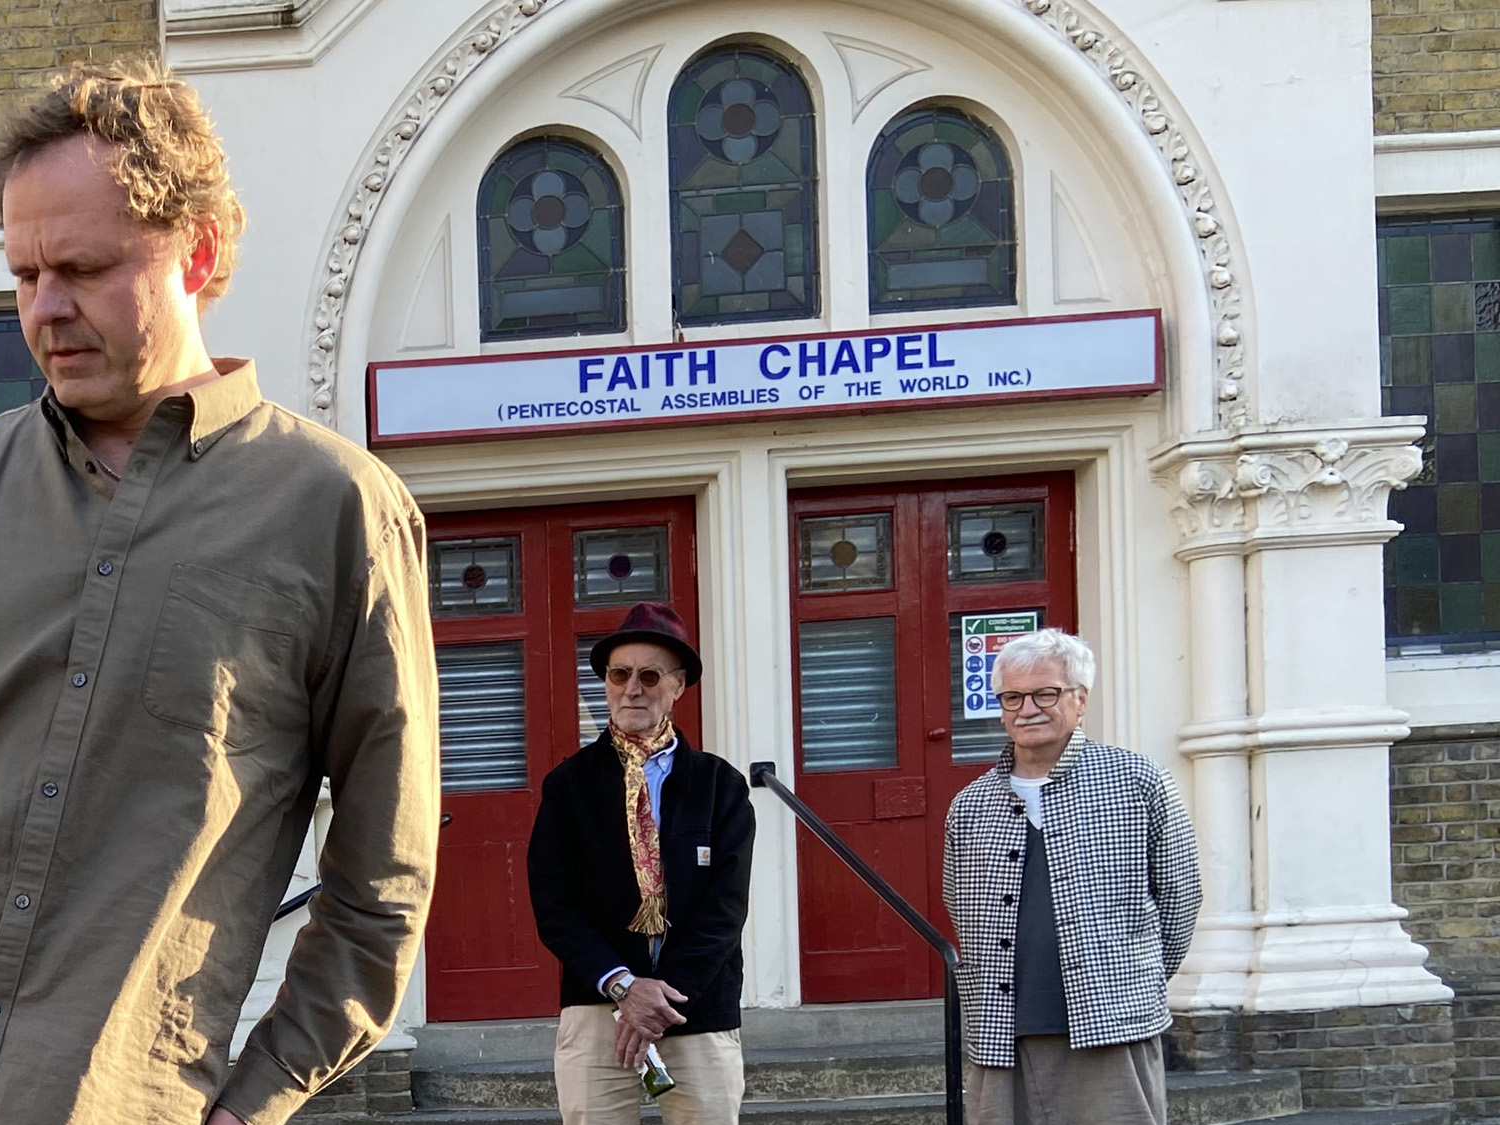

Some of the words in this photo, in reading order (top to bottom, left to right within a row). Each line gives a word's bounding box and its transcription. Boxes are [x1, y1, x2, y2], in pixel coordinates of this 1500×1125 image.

[579, 350, 716, 393] FAITH
[758, 333, 955, 380] CHAPEL
[498, 398, 641, 421] (PENTECOSTAL
[661, 388, 779, 410] ASSEMBLIES
[799, 385, 825, 400] OF
[844, 381, 882, 397] THE
[900, 375, 969, 393] WORLD
[988, 368, 1032, 387] INC.)
